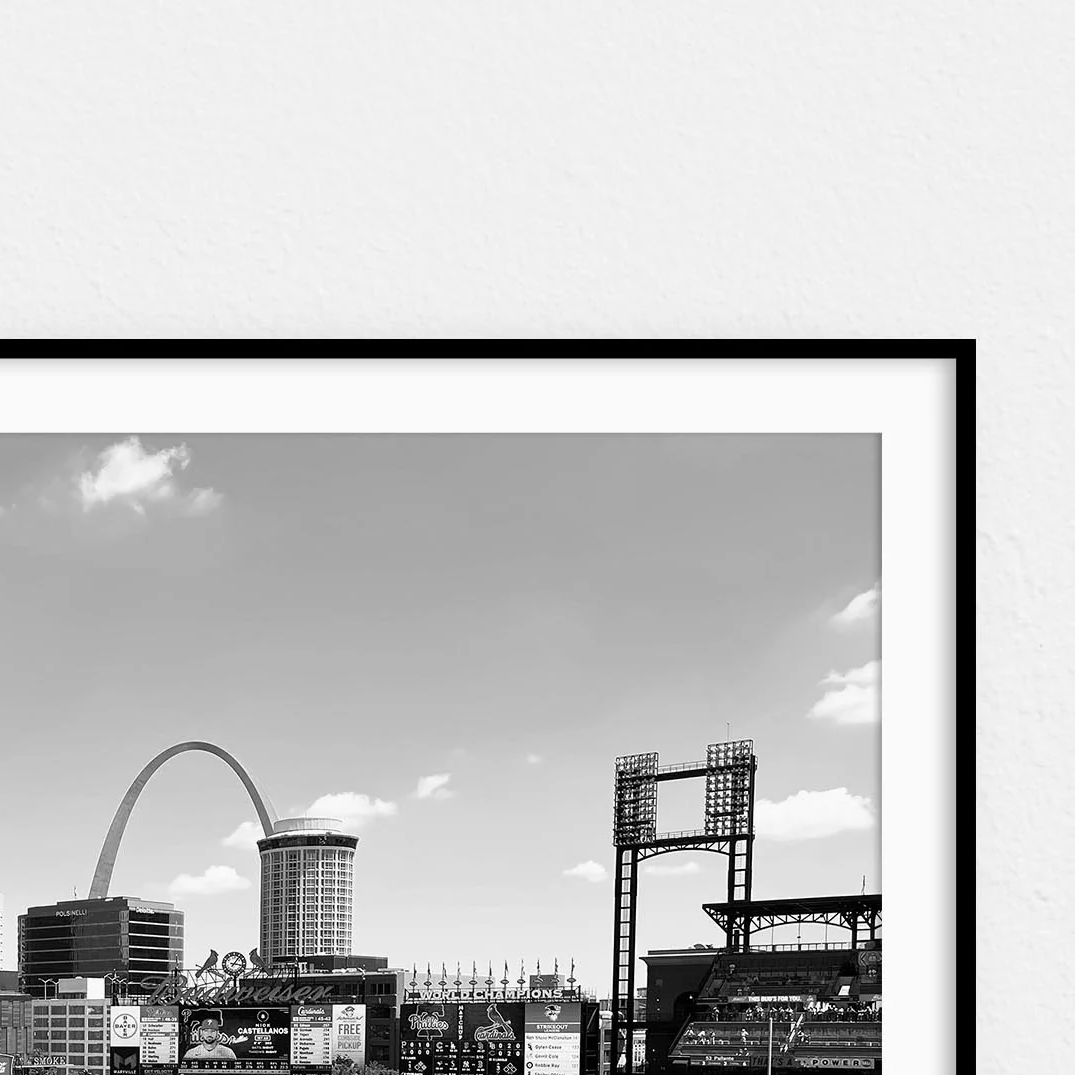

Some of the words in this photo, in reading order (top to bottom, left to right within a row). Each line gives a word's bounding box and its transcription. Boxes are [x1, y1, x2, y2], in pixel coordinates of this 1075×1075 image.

[419, 990, 470, 1000] WORLD
[473, 989, 563, 1000] CHAMPIONS
[408, 1012, 449, 1031] Phillies
[338, 1023, 361, 1035] FREE
[337, 1041, 362, 1049] PICKUP
[33, 1057, 65, 1065] SMOKE
[813, 1059, 859, 1067] POWER
